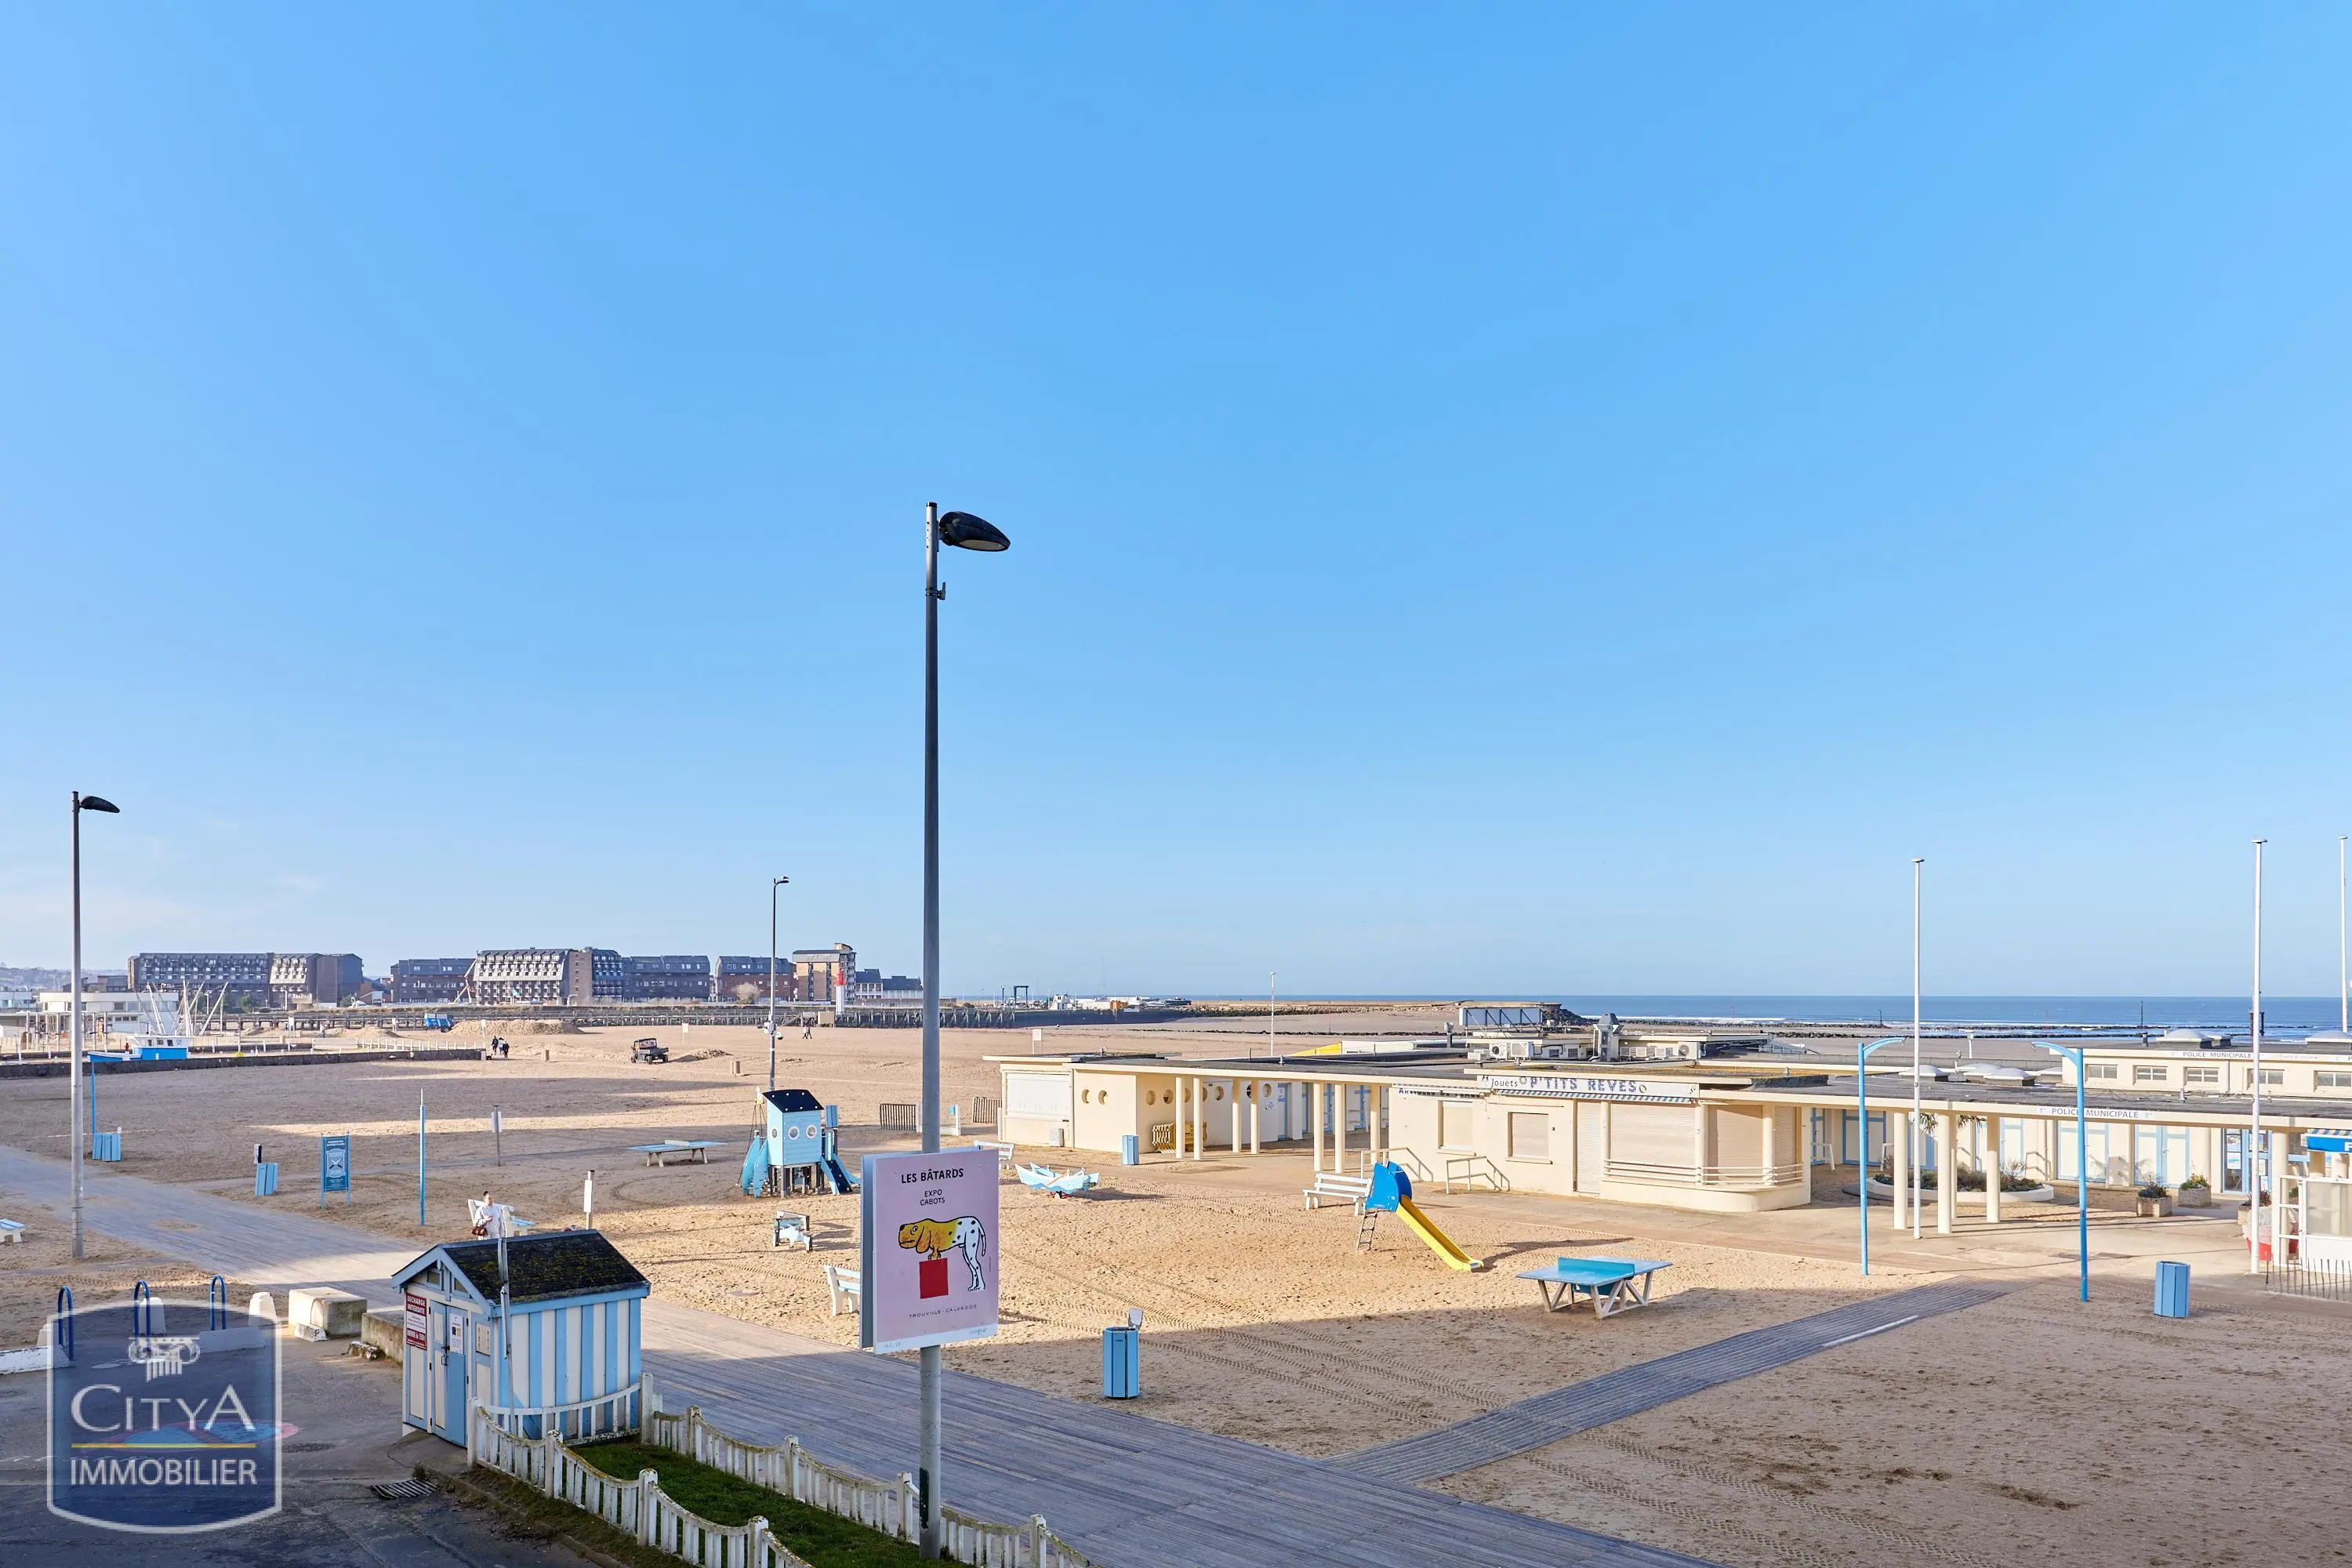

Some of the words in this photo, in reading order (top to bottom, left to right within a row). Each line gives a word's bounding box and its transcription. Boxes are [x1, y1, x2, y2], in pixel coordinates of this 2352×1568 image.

[2085, 1109, 2139, 1118] MUNICIPALE
[901, 1173, 917, 1184] LES
[920, 1168, 964, 1181] BÂTARDS
[924, 1189, 942, 1197] EXPO
[920, 1196, 946, 1206] CABOTS
[909, 1309, 941, 1318] TROUVILLE
[946, 1304, 977, 1313] CALVADOS
